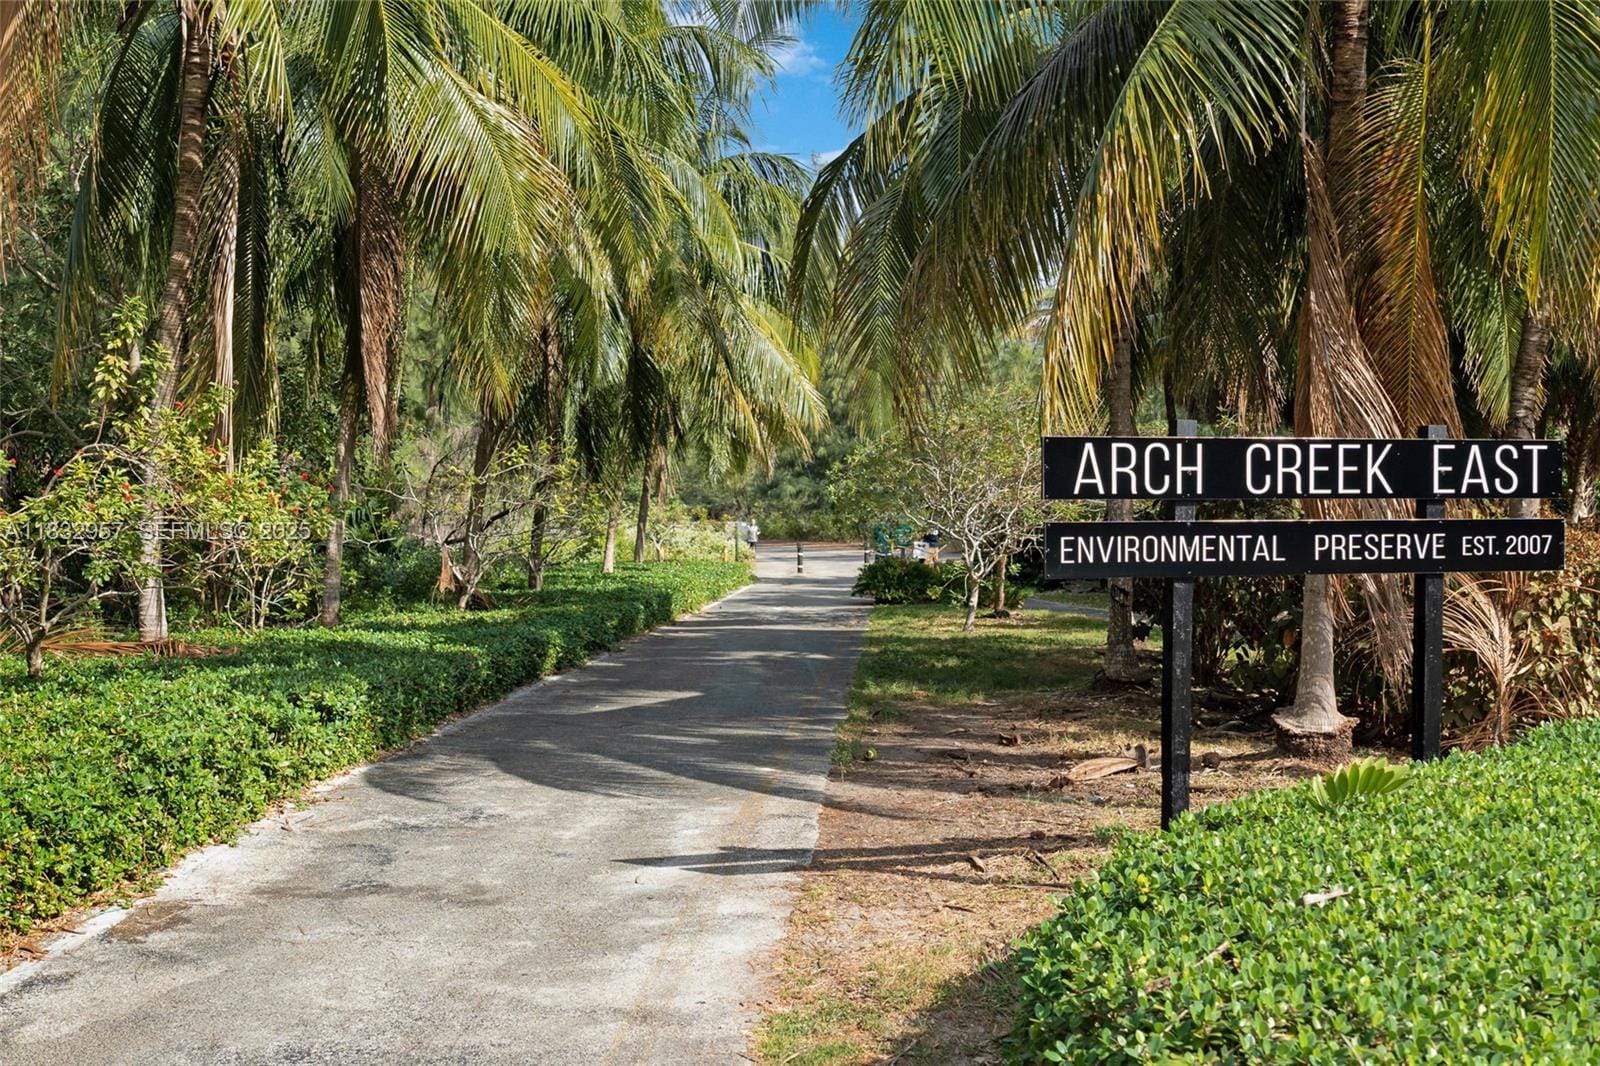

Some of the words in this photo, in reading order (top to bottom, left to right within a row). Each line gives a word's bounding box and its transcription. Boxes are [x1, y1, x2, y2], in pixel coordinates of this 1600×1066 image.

[1073, 443, 1204, 495] ARCH
[1245, 443, 1393, 495] CREEK
[1432, 444, 1548, 495] EAST
[1060, 535, 1286, 563] ENVIRONMENTAL
[1314, 533, 1446, 561] PRESERVE
[1461, 536, 1499, 556] EST.
[1505, 534, 1552, 556] 2007
